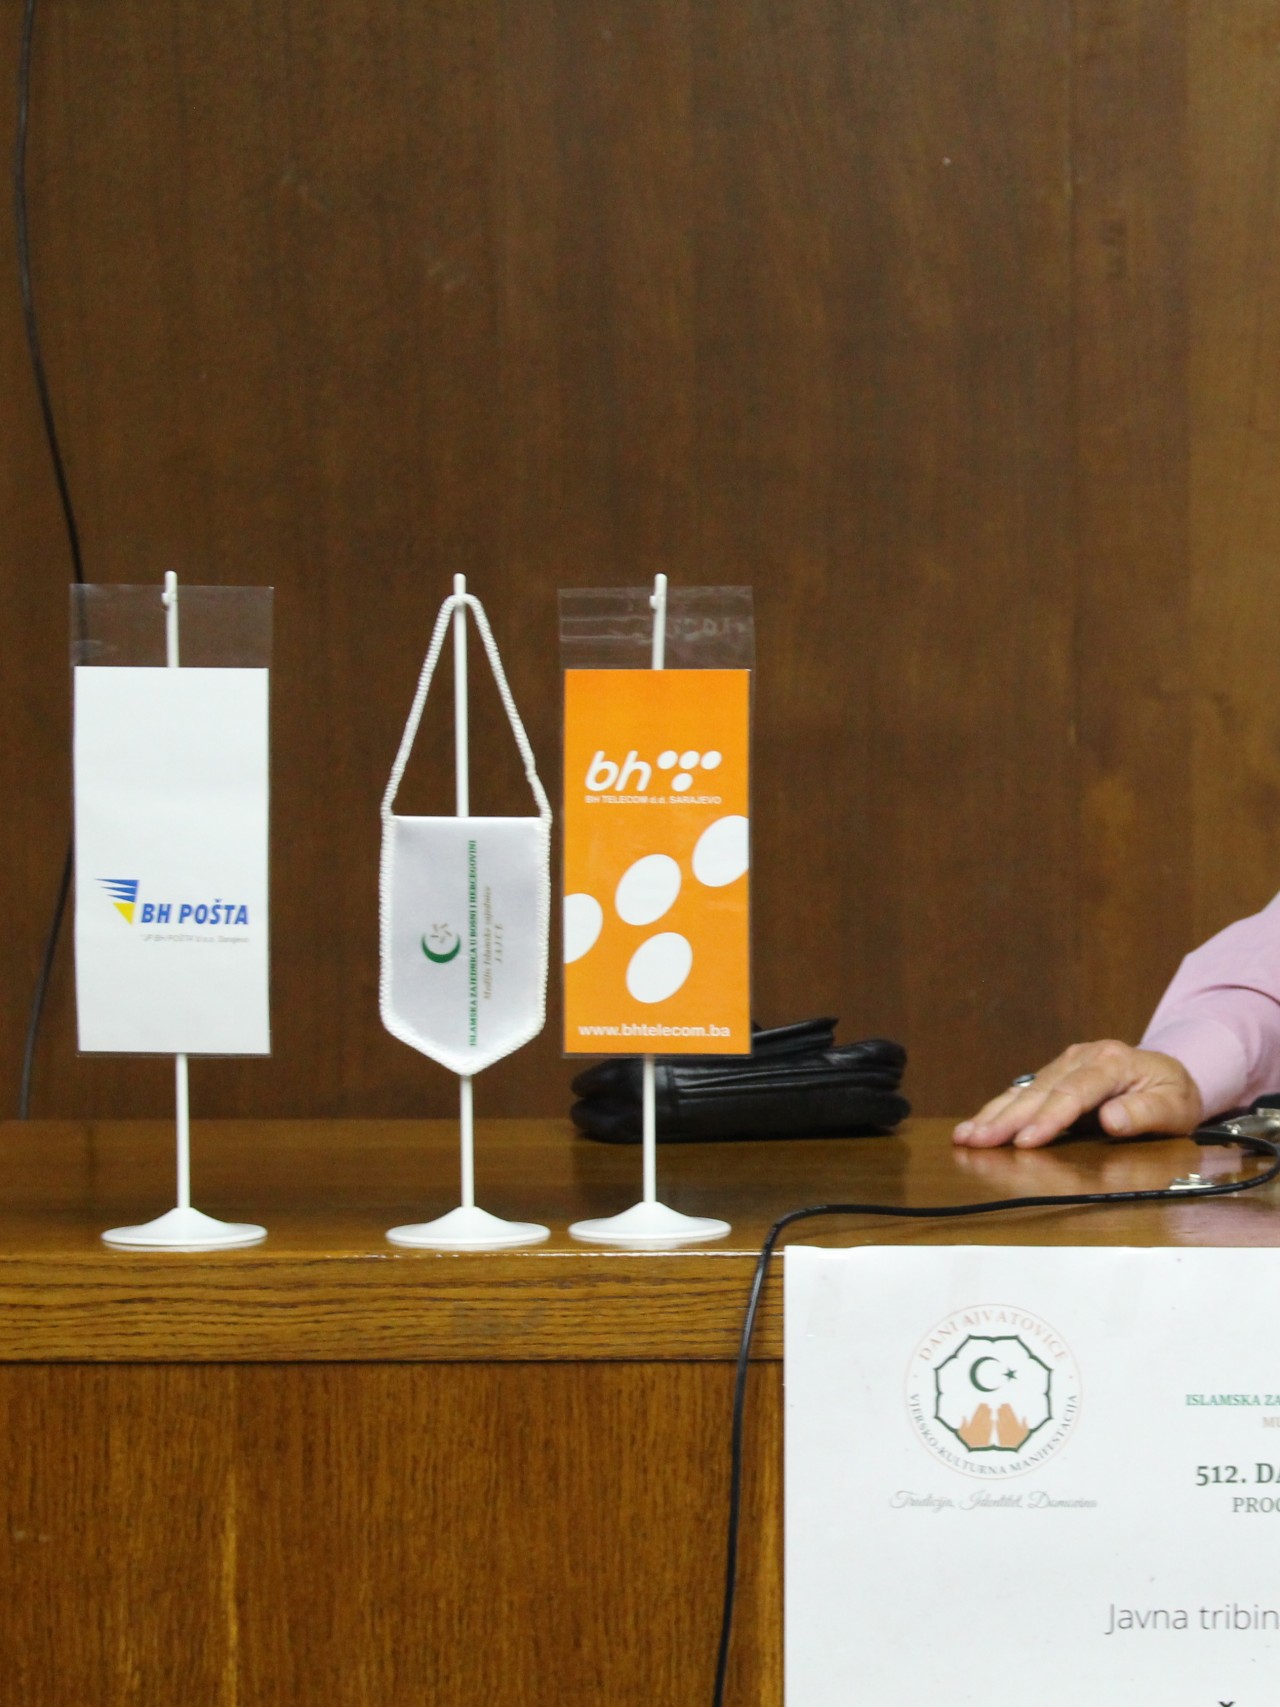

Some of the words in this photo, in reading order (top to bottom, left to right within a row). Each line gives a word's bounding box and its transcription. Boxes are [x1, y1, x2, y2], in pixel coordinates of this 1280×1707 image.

[584, 795, 600, 804] BH
[601, 795, 648, 804] TELECOM
[669, 796, 722, 804] SARAJEVO
[467, 840, 477, 903] HERCEGOVINI
[141, 903, 172, 923] BH
[178, 899, 249, 925] POŠTA
[467, 910, 477, 938] BOSNI
[467, 947, 478, 998] ZAJEDNICA
[467, 999, 478, 1047] ISLAMSKA
[577, 1023, 731, 1037] www.bhtelecom.ba
[919, 1321, 959, 1361] DANI
[963, 1310, 1068, 1362] AJVATOVICE
[1185, 1394, 1261, 1406] ISLAMSKA
[1009, 1394, 1078, 1474] MANIFESTACIJA
[1195, 1465, 1247, 1486] 512.
[1104, 1603, 1188, 1635] Javna
